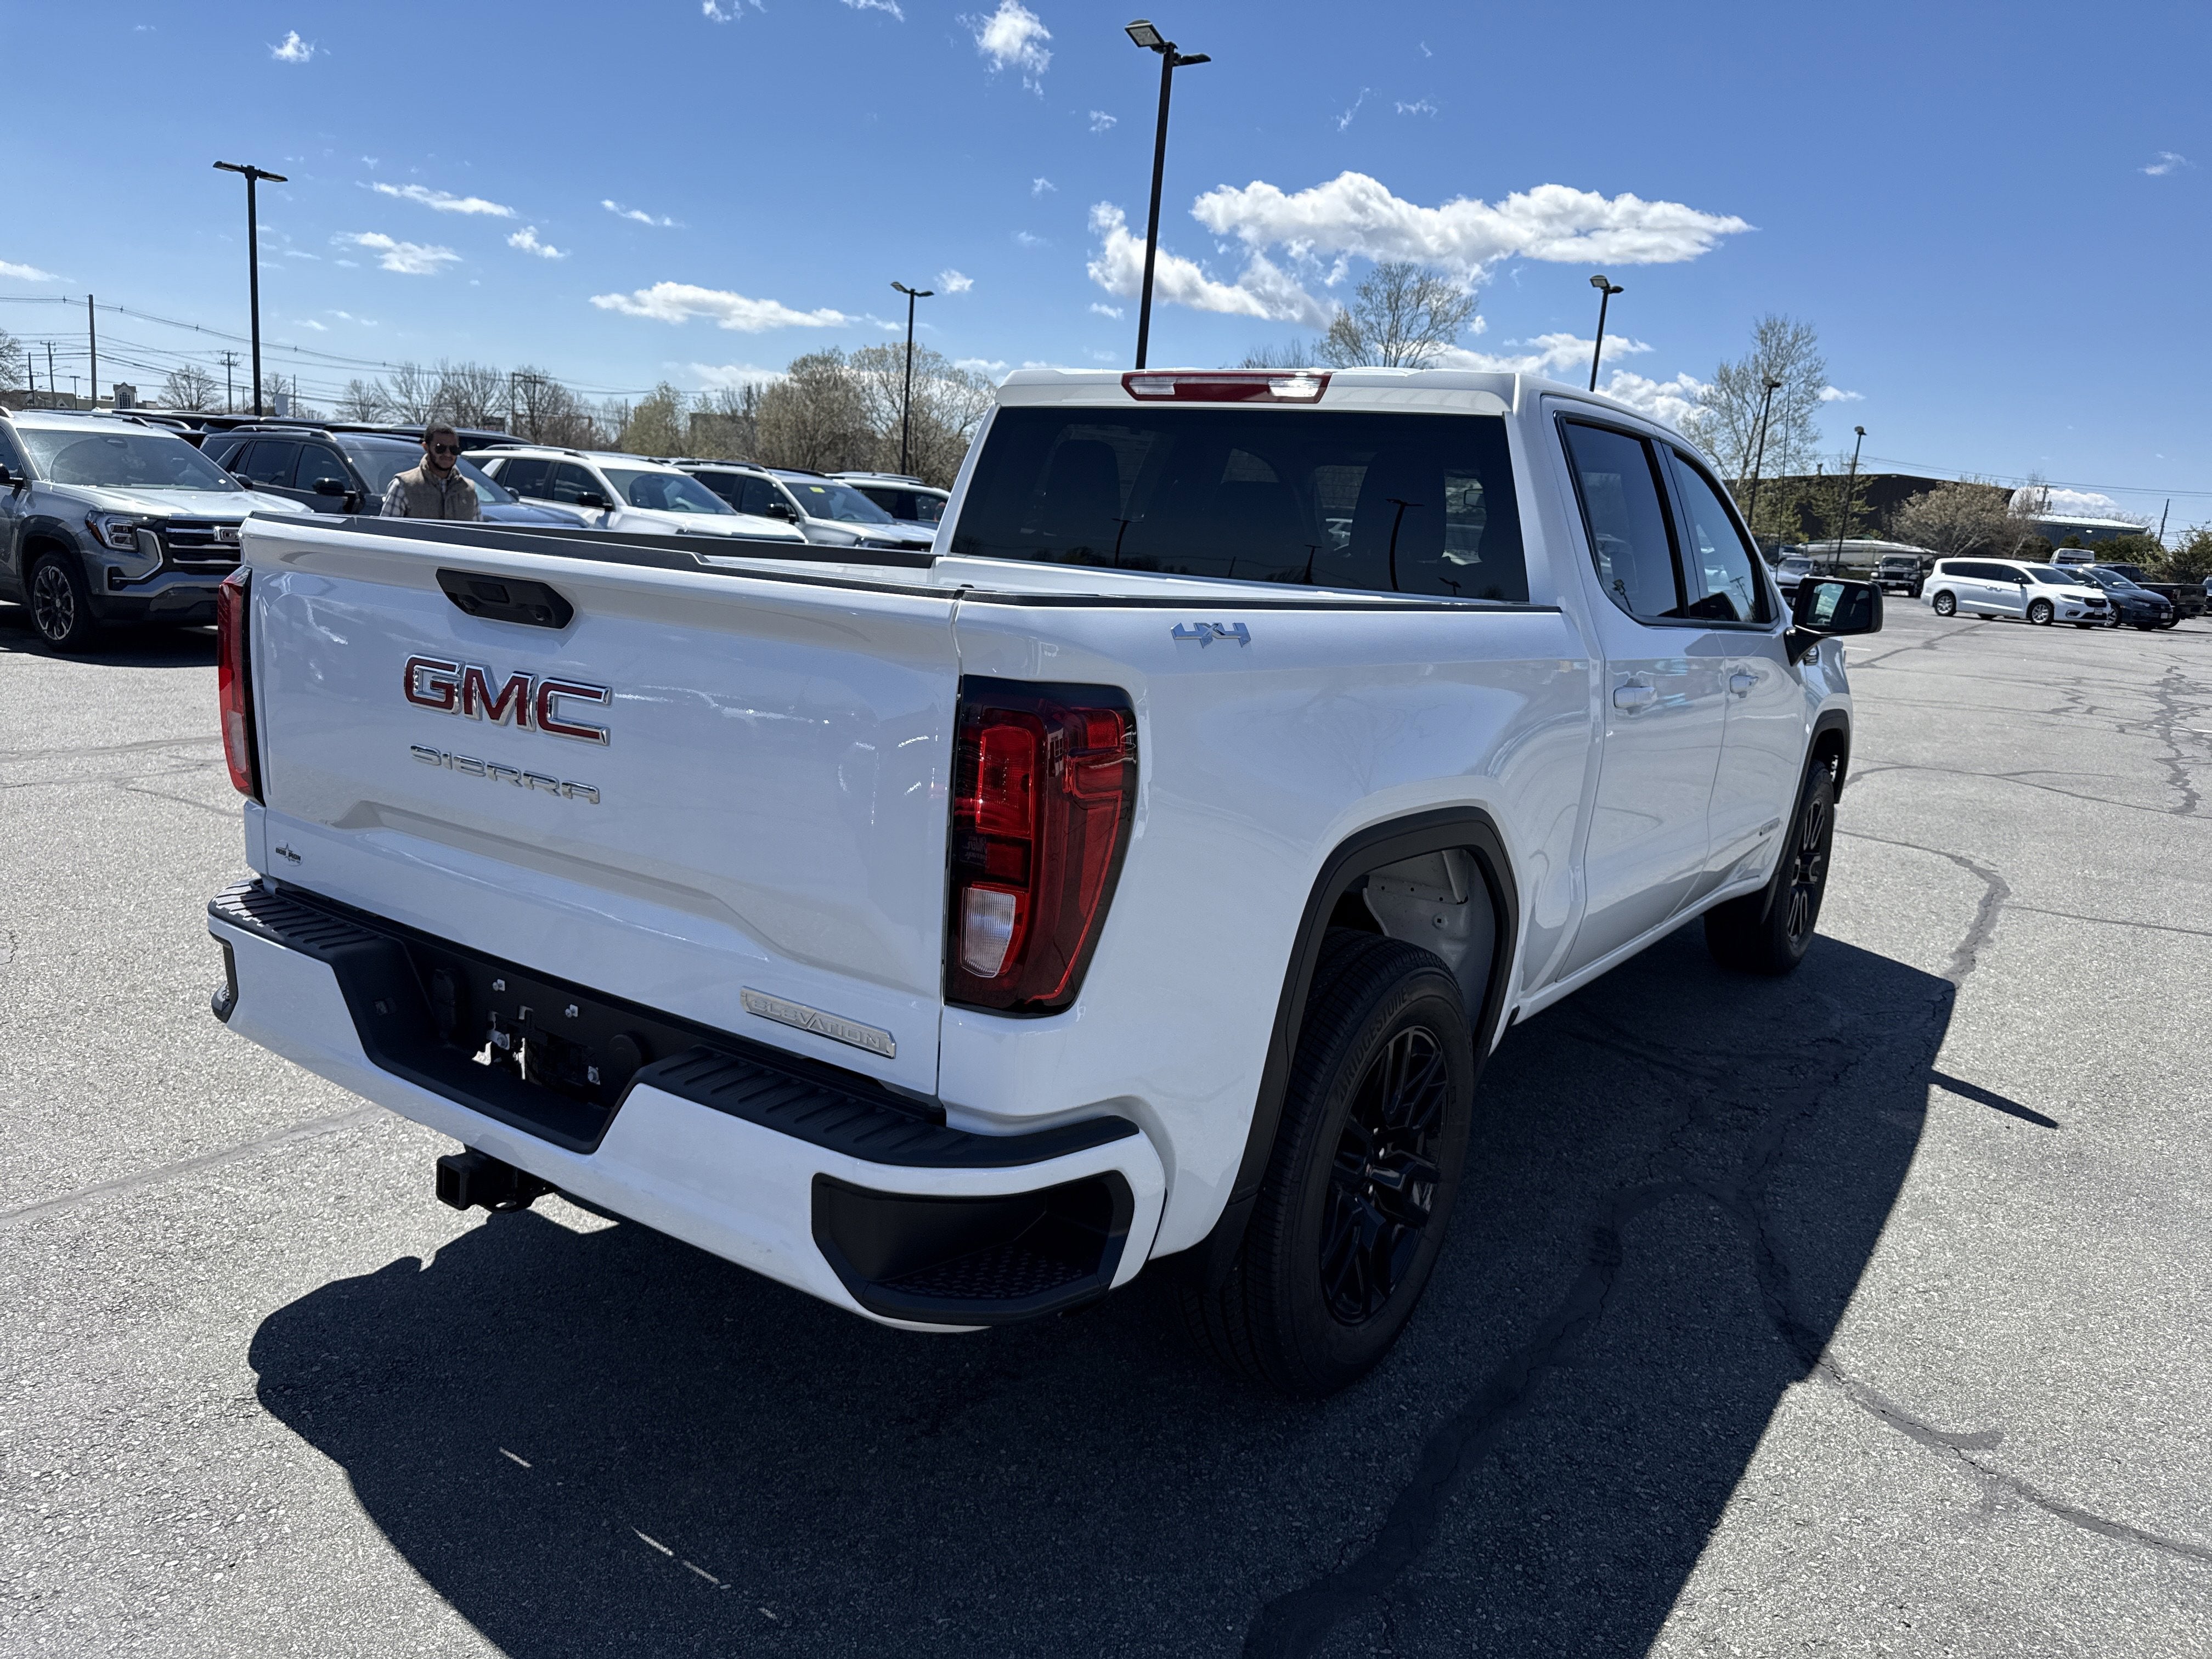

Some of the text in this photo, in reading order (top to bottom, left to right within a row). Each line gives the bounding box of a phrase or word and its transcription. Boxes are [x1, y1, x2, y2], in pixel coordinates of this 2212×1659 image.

[403, 653, 612, 747] GMC
[409, 743, 600, 805] SIERRA
[751, 997, 881, 1048] ELEVATION
